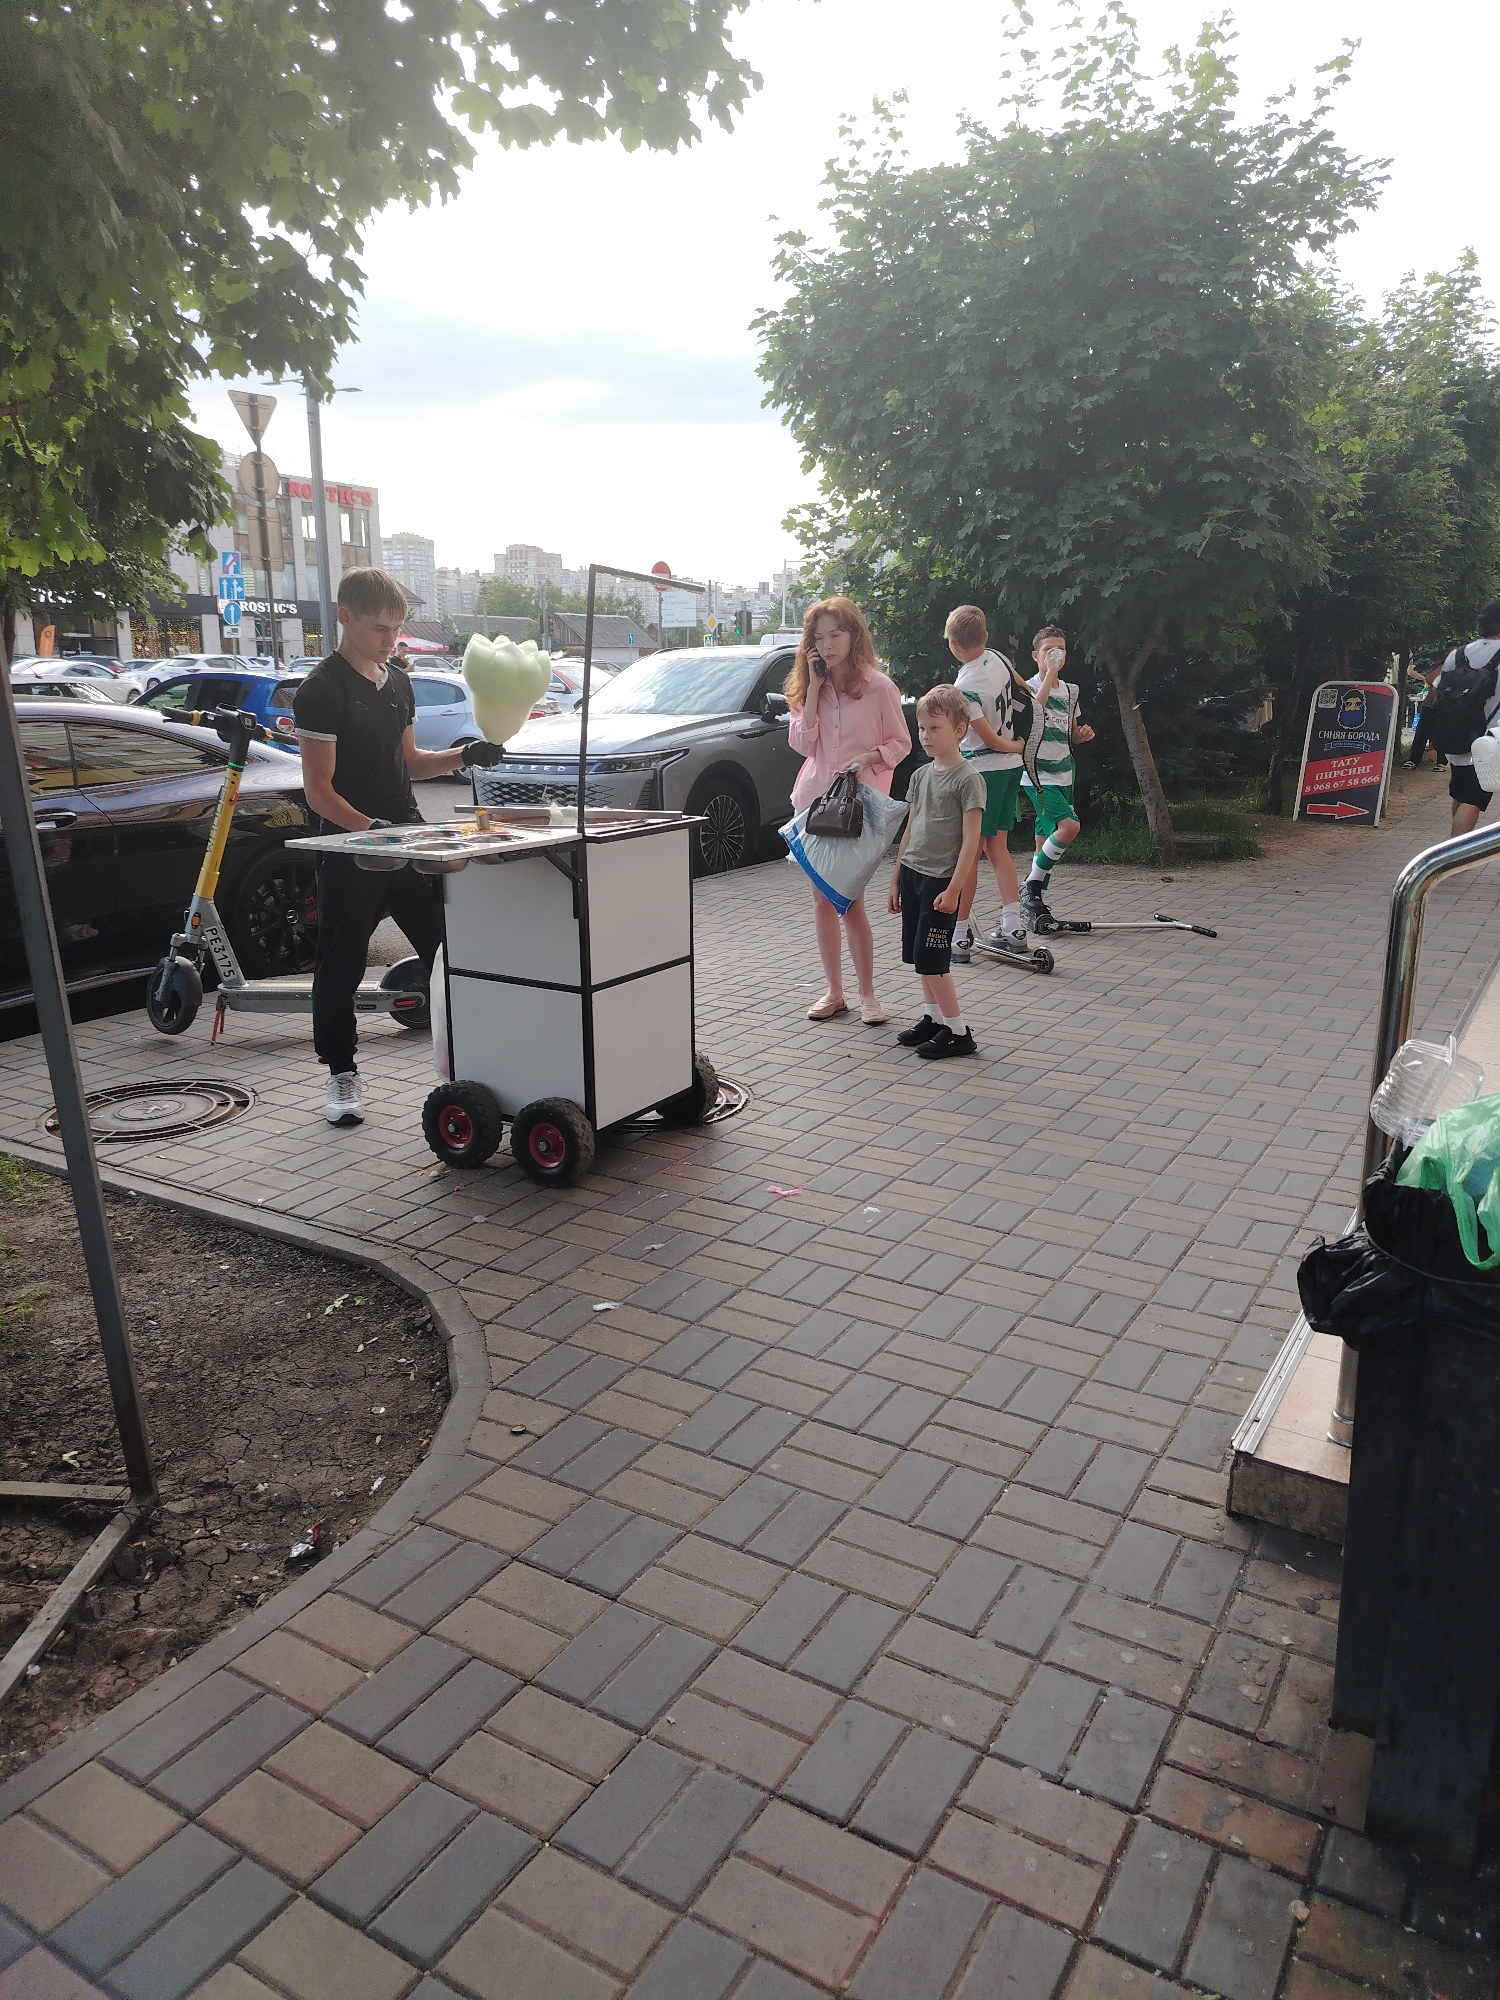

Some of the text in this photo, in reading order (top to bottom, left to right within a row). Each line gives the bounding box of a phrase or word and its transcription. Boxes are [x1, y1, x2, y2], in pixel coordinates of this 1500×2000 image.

[288, 481, 373, 507] ROTIC'S
[1318, 730, 1380, 741] СИНЯЯ БОРОДА
[1331, 756, 1361, 768] ТАТУ
[1315, 765, 1373, 780] ПИРСИНГ
[1313, 782, 1330, 791] 968
[1333, 780, 1345, 788] 67
[1346, 778, 1359, 786] 58
[1361, 774, 1380, 784] 666
[205, 927, 236, 978] PE3175
